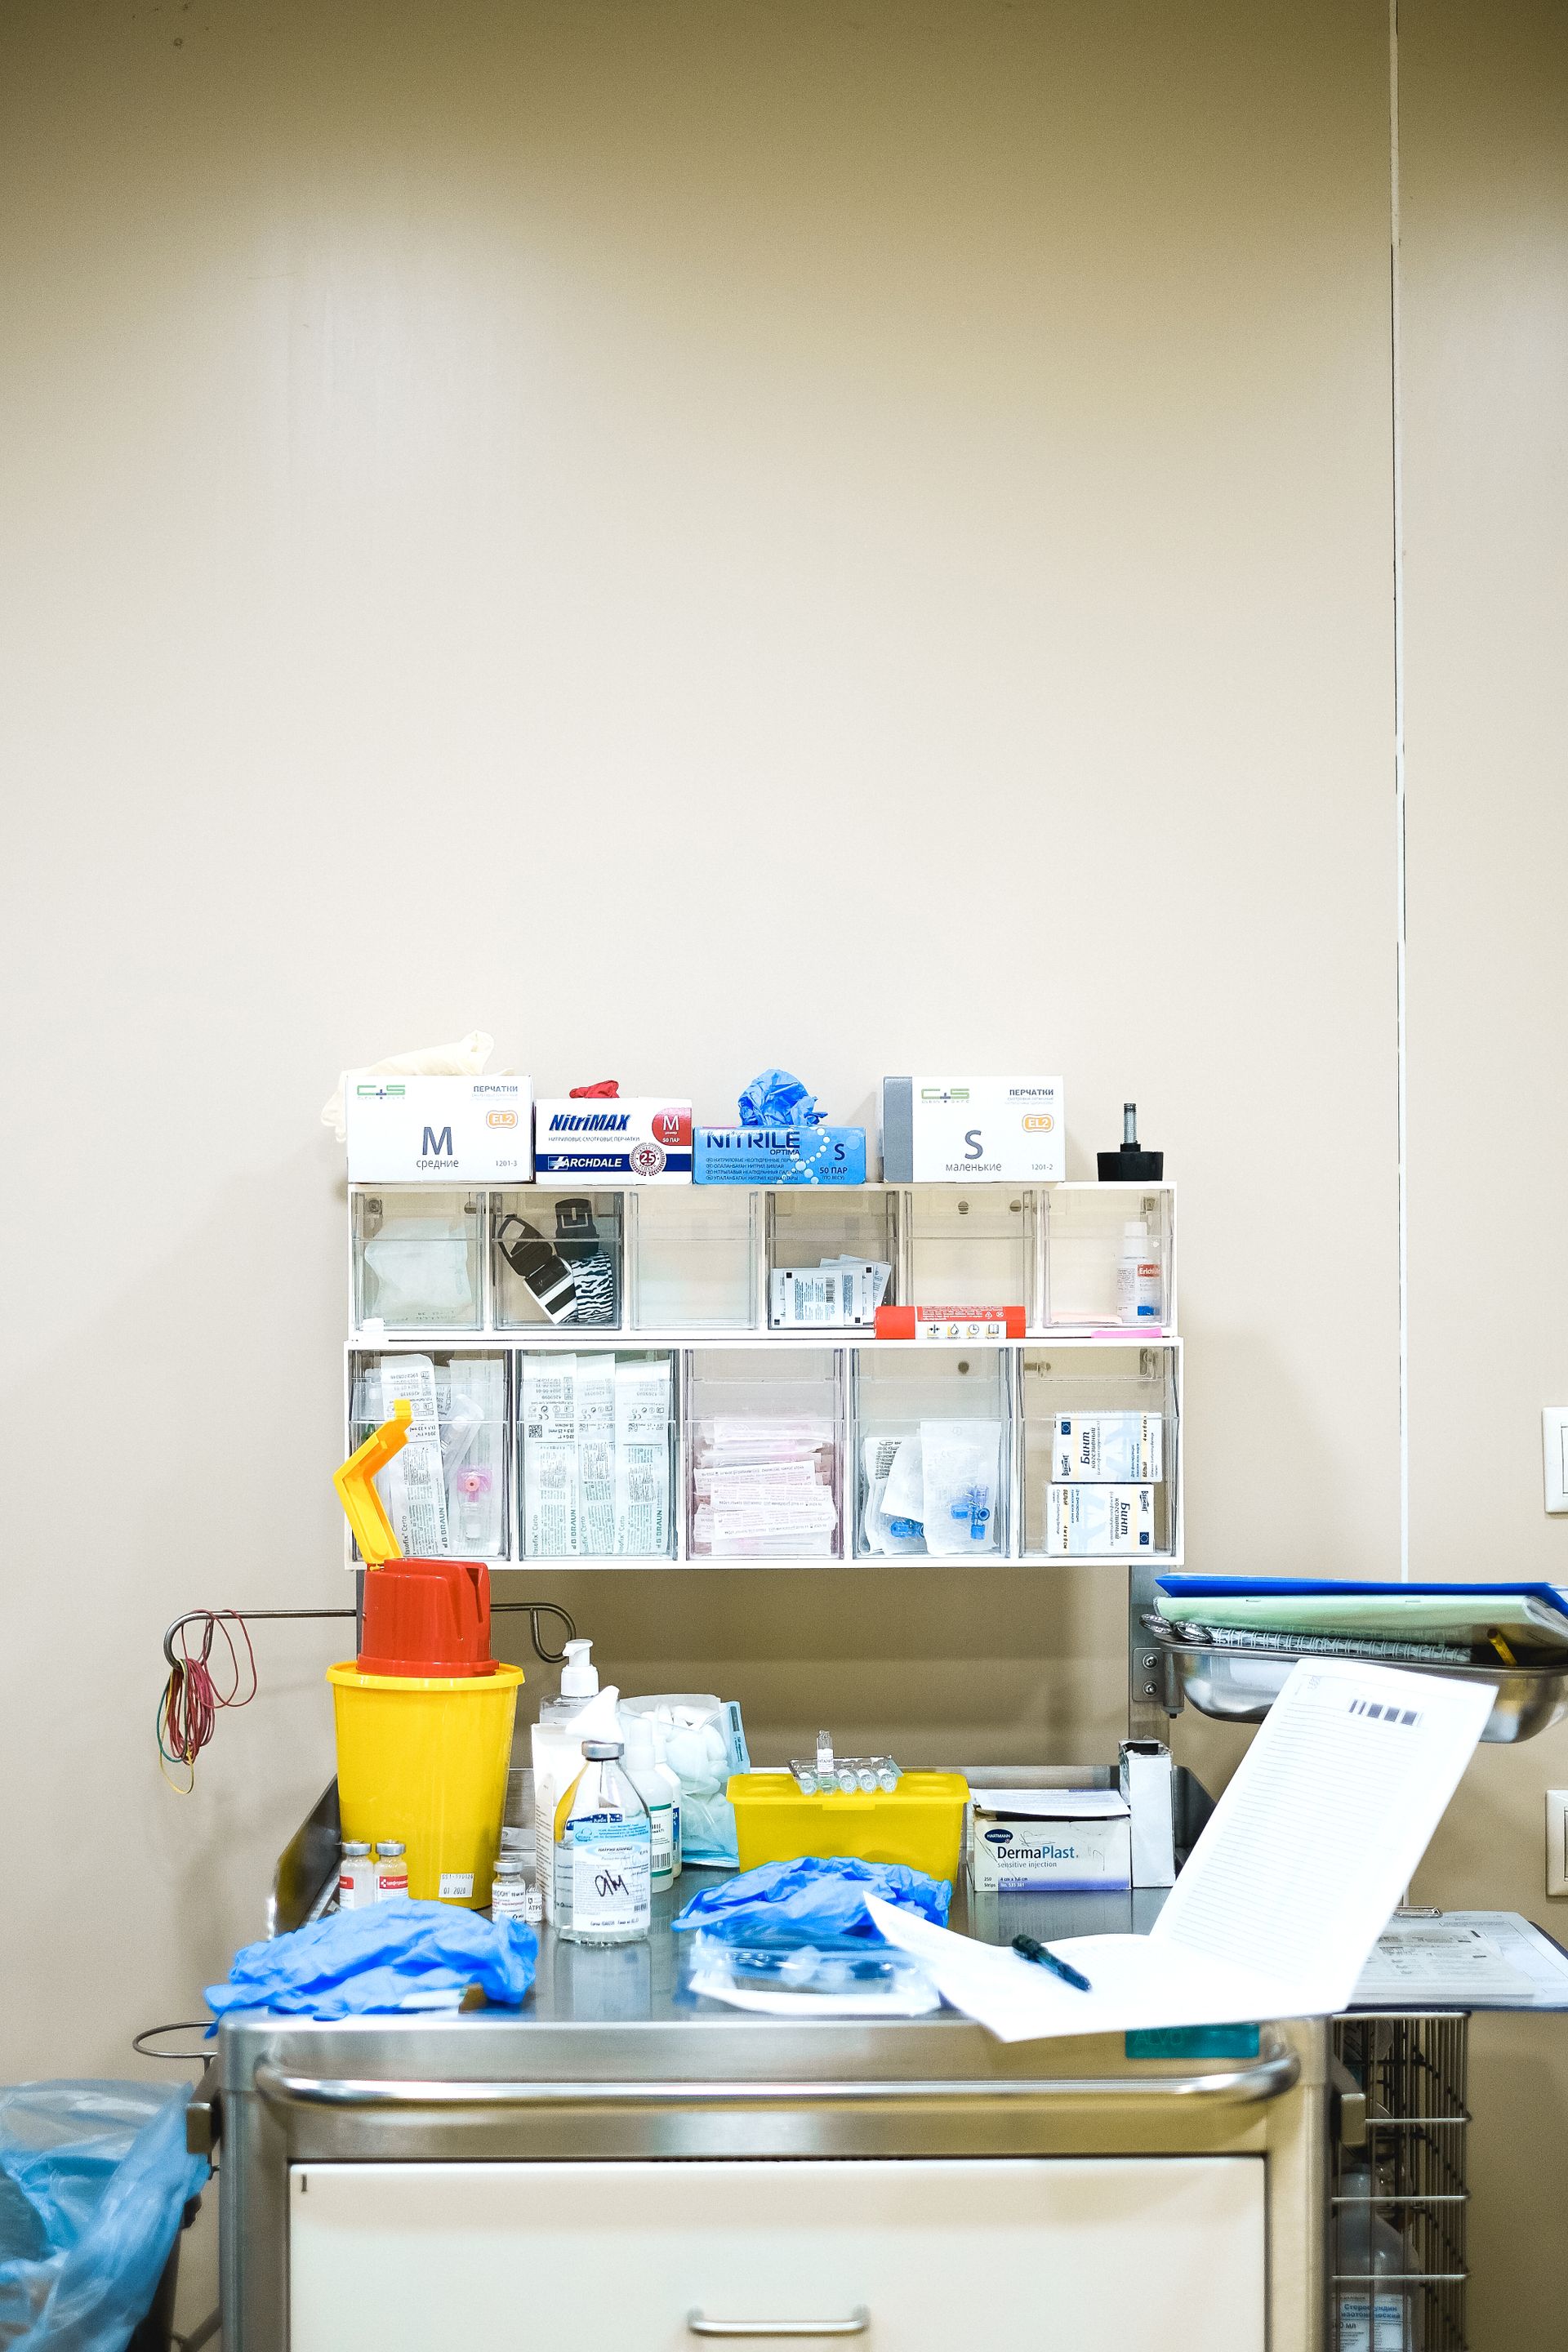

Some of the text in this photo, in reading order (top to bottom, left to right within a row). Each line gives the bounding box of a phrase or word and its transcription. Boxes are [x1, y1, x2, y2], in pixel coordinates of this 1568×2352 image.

[492, 1115, 514, 1125] EL2
[548, 1113, 631, 1131] NitriMAX
[662, 1115, 679, 1131] M
[1028, 1119, 1049, 1128] EL2
[421, 1126, 453, 1156] M
[706, 1131, 800, 1149] NITRILE
[964, 1129, 984, 1160] S
[640, 1152, 655, 1163] 25
[834, 1143, 846, 1161] S
[416, 1158, 459, 1170] средние
[564, 1158, 623, 1168] ARCHDALE
[819, 1166, 848, 1174] 50 ПАР
[945, 1163, 1002, 1172] маленькие
[1080, 1432, 1090, 1464] Бинт
[400, 1515, 408, 1532] Certo
[439, 1507, 447, 1535] BRAUN
[1120, 1502, 1130, 1535] Бинт
[997, 1846, 1075, 1859] DermaPlast
